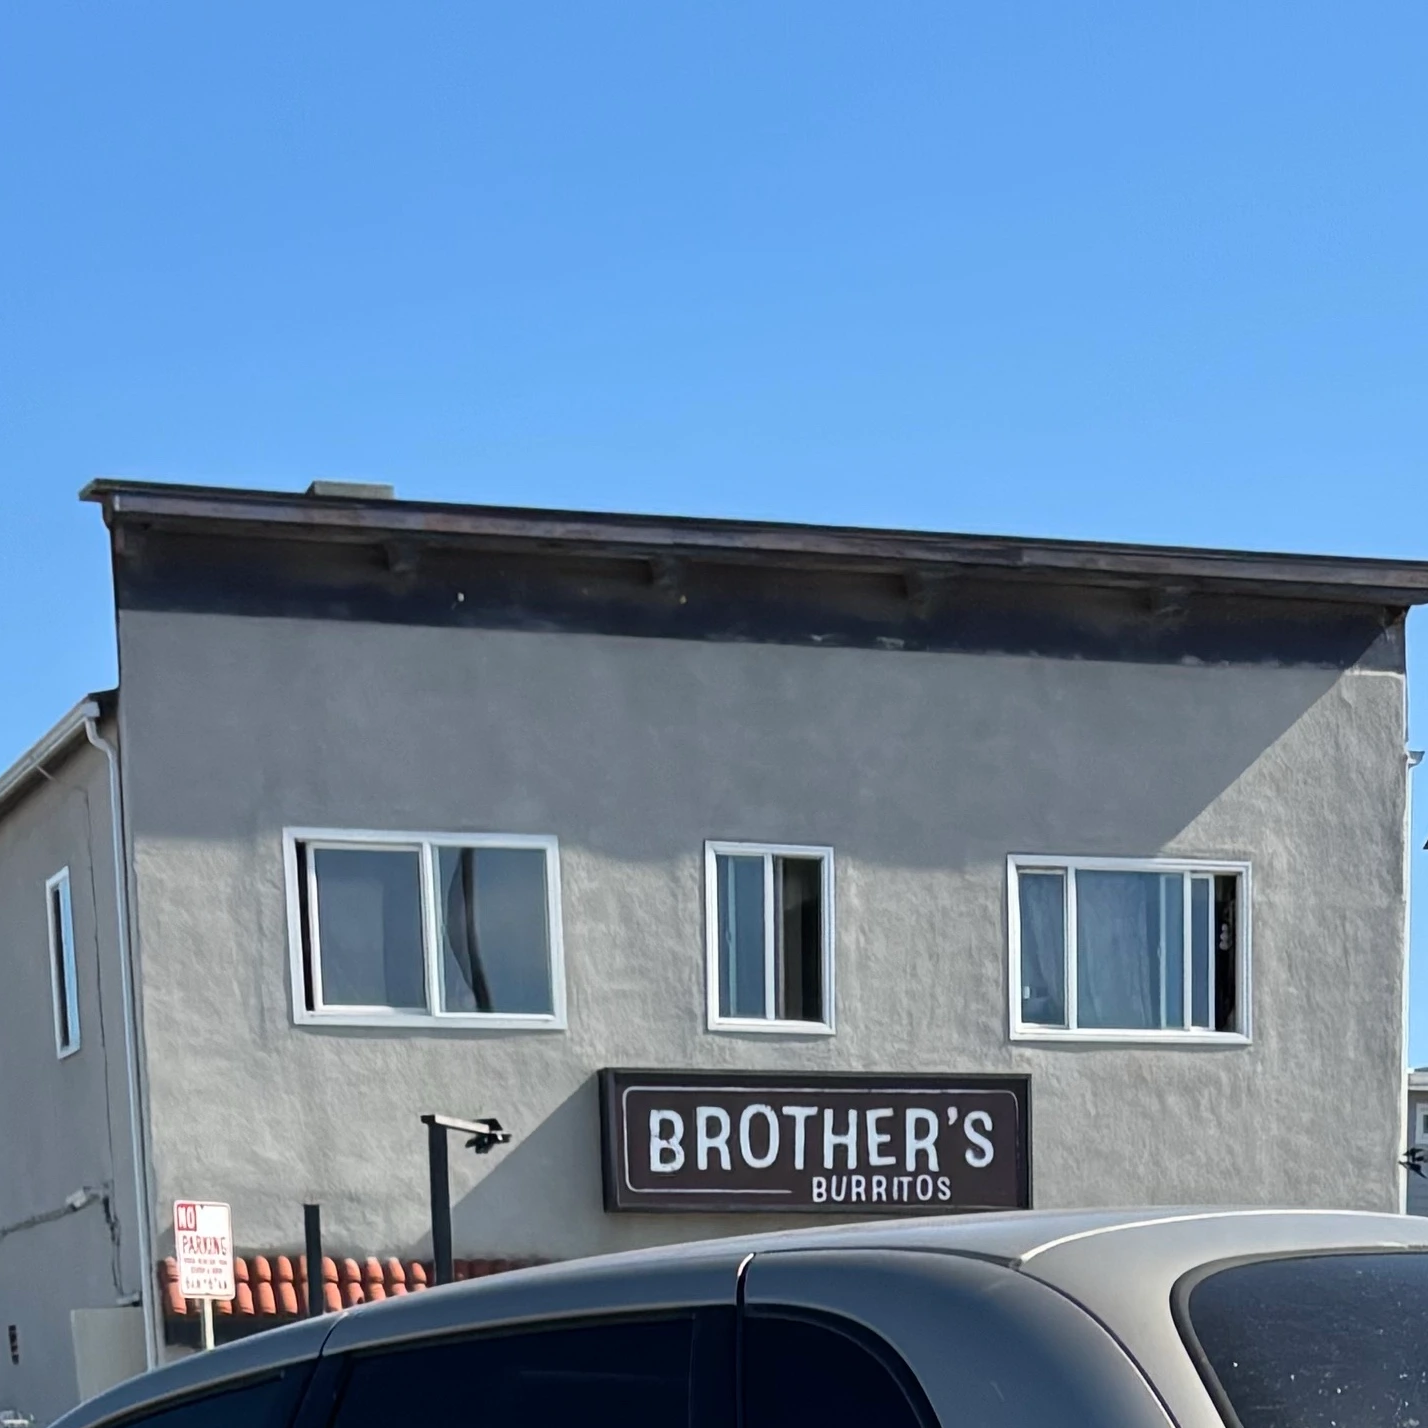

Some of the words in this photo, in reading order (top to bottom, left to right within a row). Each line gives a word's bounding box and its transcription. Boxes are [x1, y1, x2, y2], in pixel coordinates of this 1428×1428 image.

[649, 1104, 994, 1173] BROTHER'S
[812, 1174, 952, 1202] BURRITOS
[178, 1206, 196, 1229] NO
[182, 1235, 227, 1255] PARKING
